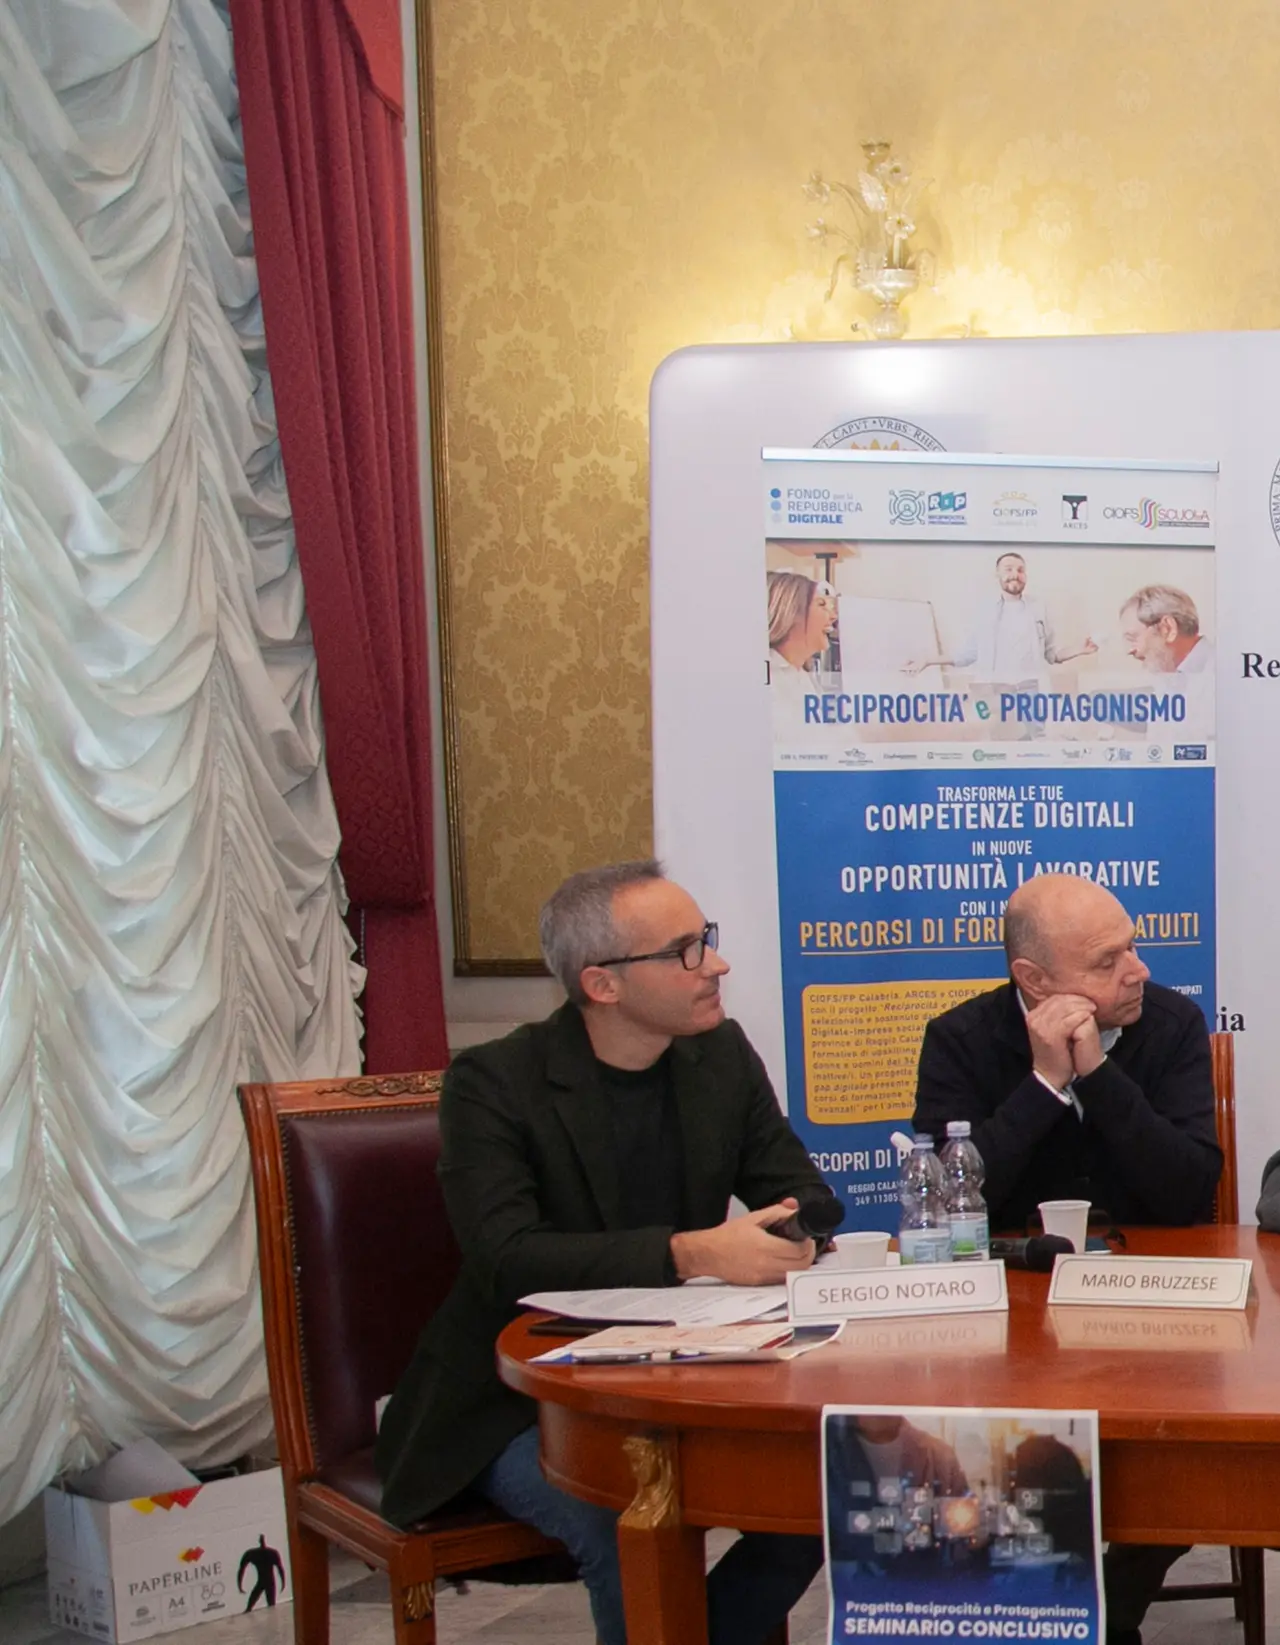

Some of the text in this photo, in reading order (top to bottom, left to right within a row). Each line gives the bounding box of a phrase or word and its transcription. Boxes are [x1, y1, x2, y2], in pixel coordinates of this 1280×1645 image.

[788, 489, 830, 499] FONDO
[788, 501, 862, 512] REPUBBLICA
[1103, 507, 1209, 520] CIOFS SCUOLA
[788, 514, 843, 523] DIGITALE
[976, 701, 990, 720] e
[1001, 693, 1186, 723] PROTAGONISMO
[938, 786, 1063, 801] TRASFORMA LE TUE
[866, 802, 1134, 831] COMPETENZE DIGITALI
[972, 841, 1032, 856] IN NUOVE
[842, 858, 1007, 892] OPPORTUNITÀ
[961, 902, 982, 916] CON
[989, 902, 993, 915] I
[801, 920, 912, 948] PERCORSI
[923, 918, 944, 943] DI
[1136, 912, 1199, 938] ATUITI
[810, 994, 855, 1003] CIOFS/FP
[905, 990, 936, 999] ARCES
[948, 989, 975, 998] CIOFS
[809, 1151, 869, 1172] SCOPRI
[876, 1149, 891, 1168] DI
[848, 1182, 875, 1193] REGGIO
[1082, 1273, 1218, 1291] MARIO BRUZZESE
[818, 1279, 976, 1304] SERGIO NOTARO
[129, 1561, 222, 1596] PAPERLINE
[201, 1581, 225, 1600] 80
[169, 1597, 185, 1609] A4
[846, 1601, 1088, 1620] Progetto Reciprocità e Protagonismo
[845, 1618, 1089, 1639] SEMINARIO CONCLUSIVO
